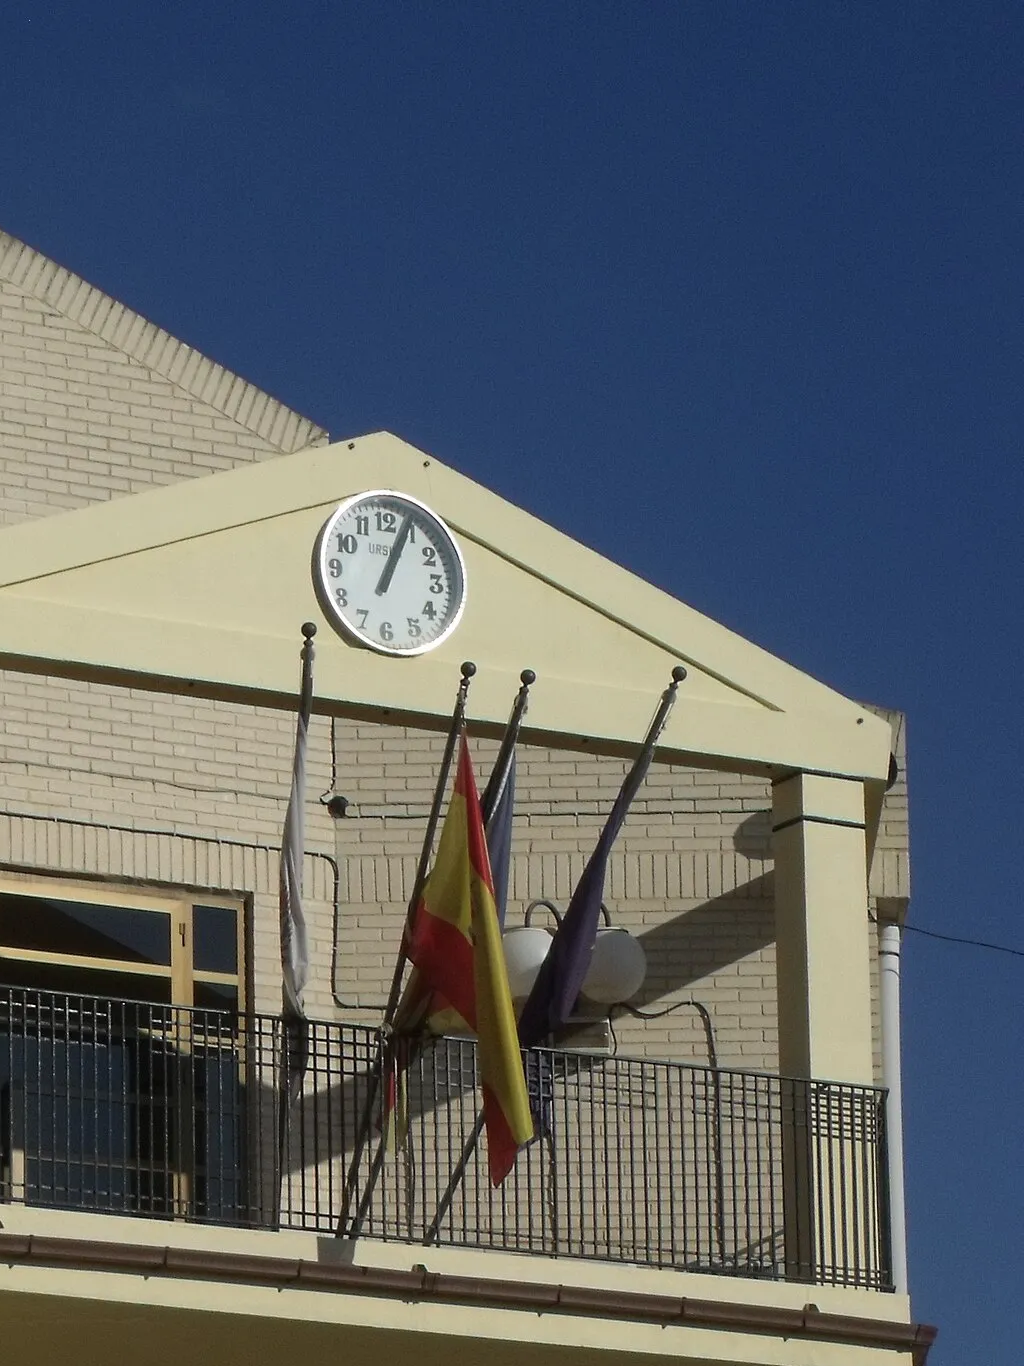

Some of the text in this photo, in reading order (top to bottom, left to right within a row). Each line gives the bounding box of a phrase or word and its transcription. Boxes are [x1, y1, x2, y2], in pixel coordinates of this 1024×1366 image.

[355, 515, 369, 536] 11
[375, 511, 396, 534] 12
[408, 522, 416, 543] 1
[336, 533, 358, 554] 10
[421, 546, 436, 567] 2
[329, 558, 343, 578] 9
[429, 574, 443, 594] 3
[335, 588, 348, 608] 8
[356, 608, 369, 629] 7
[422, 601, 437, 621] 4
[379, 622, 394, 641] 6
[407, 618, 422, 637] 5
